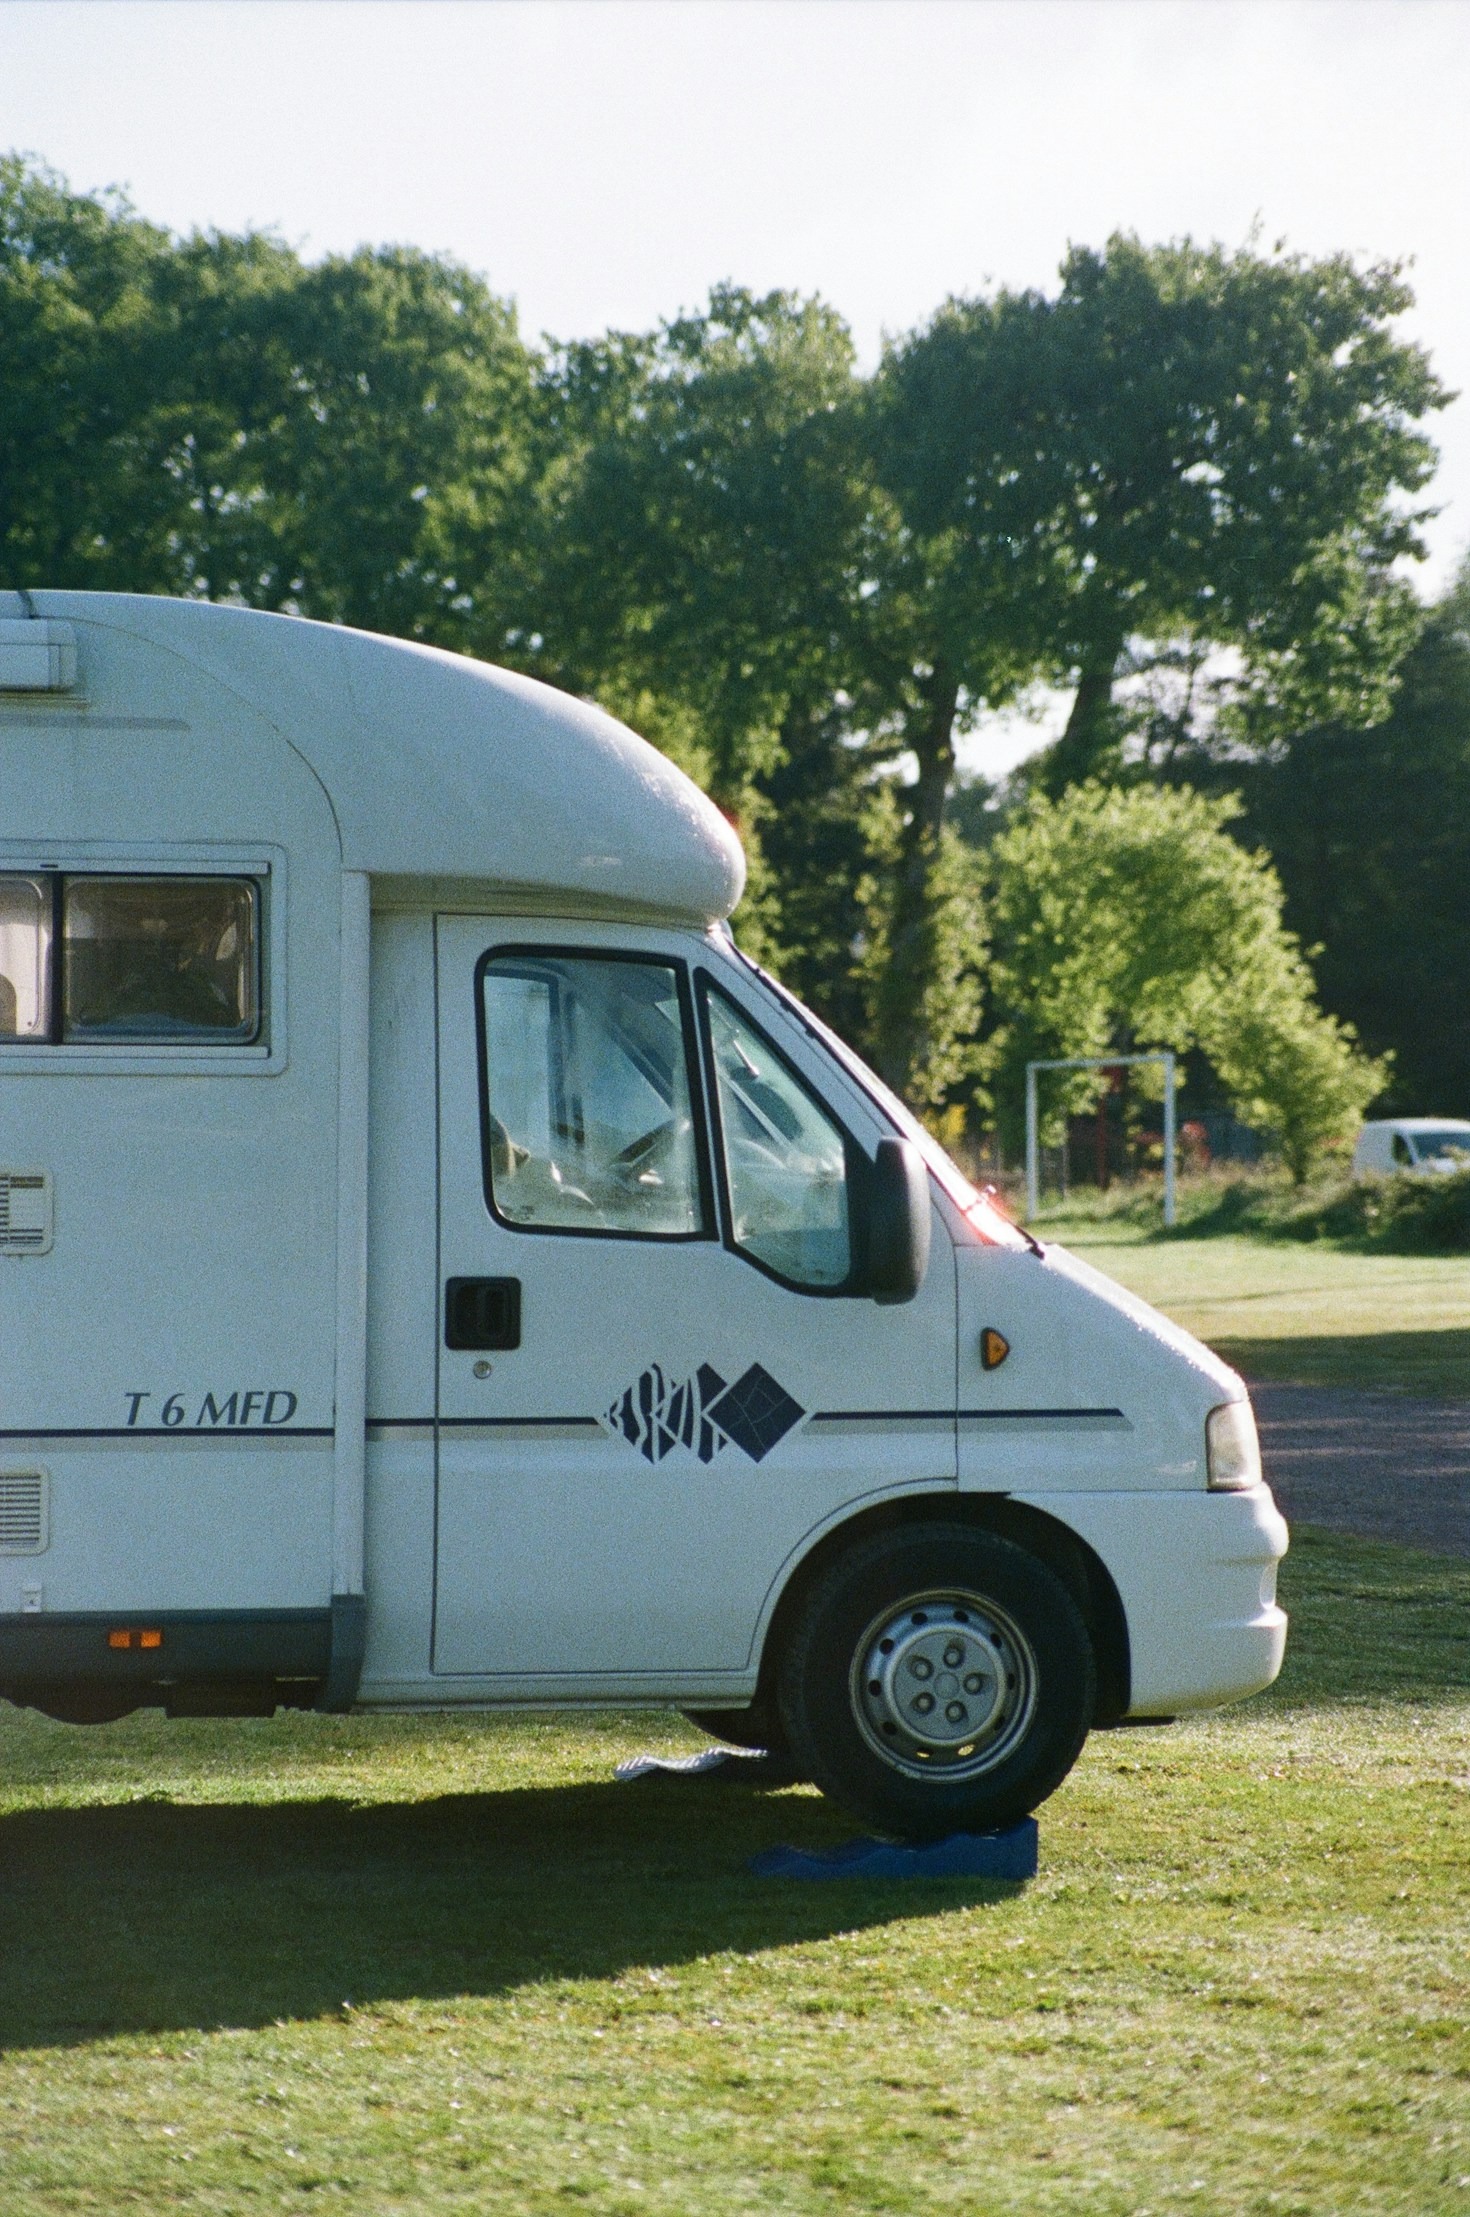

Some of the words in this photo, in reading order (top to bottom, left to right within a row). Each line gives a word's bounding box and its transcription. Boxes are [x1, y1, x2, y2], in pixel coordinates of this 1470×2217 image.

[125, 1392, 151, 1426] T
[162, 1393, 186, 1427] 6
[196, 1391, 298, 1425] MFD
